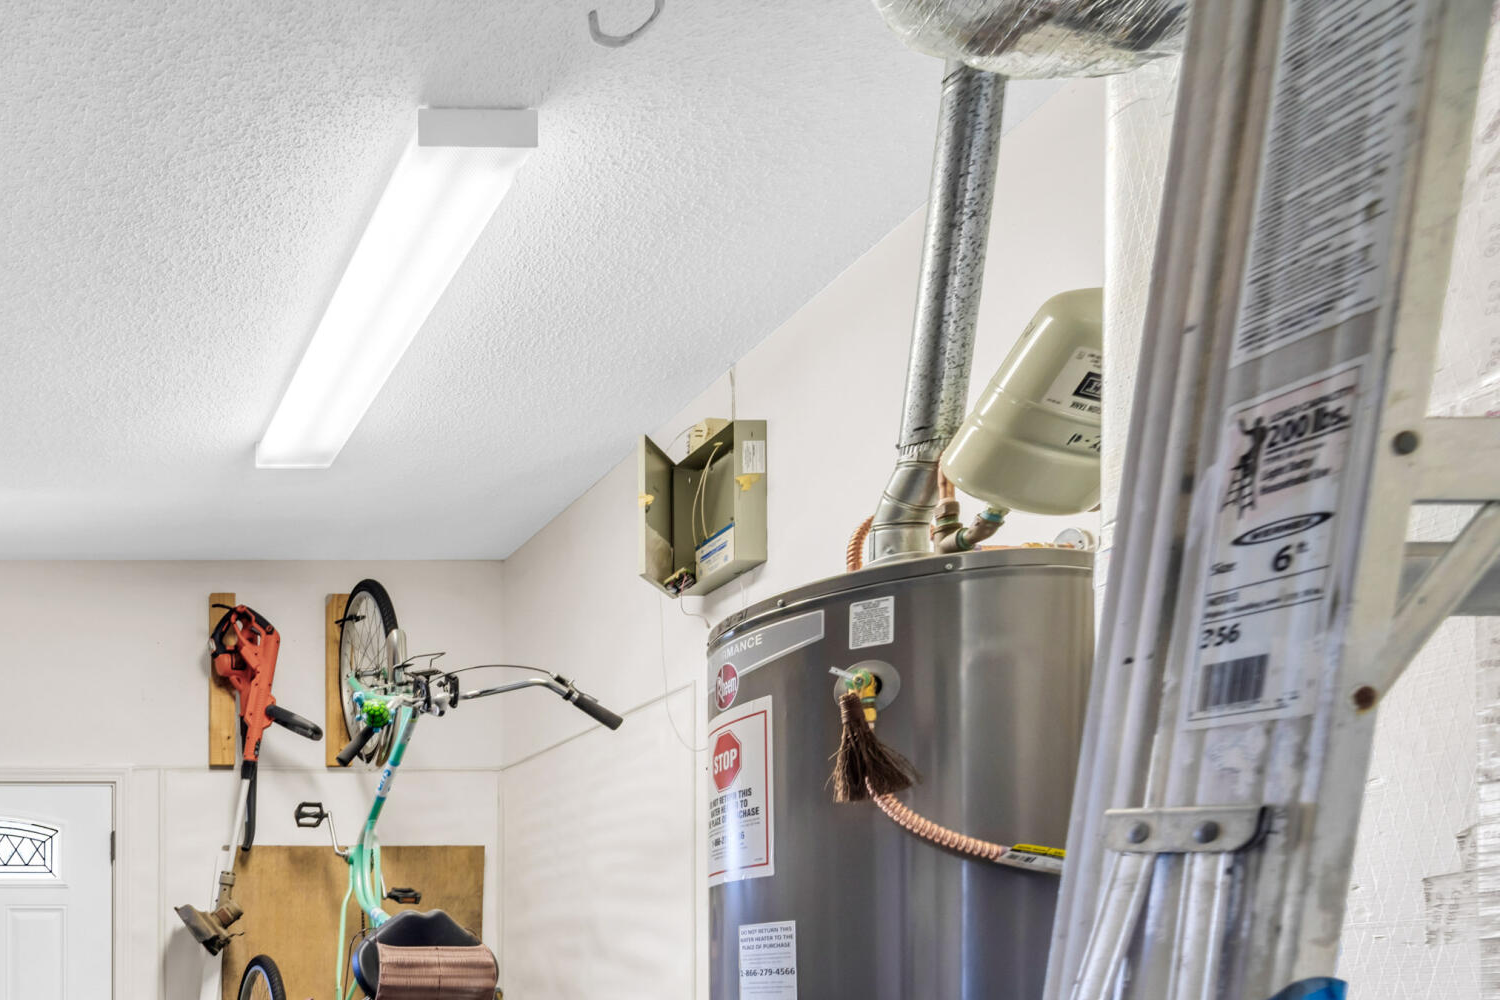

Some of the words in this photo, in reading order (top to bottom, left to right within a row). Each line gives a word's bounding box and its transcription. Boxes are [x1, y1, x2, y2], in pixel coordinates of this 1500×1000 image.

[1266, 414, 1309, 449] 200
[1272, 544, 1293, 573] 6
[714, 747, 738, 776] STOP
[738, 787, 752, 798] THIS
[740, 967, 796, 977] 1-866-279-4566
